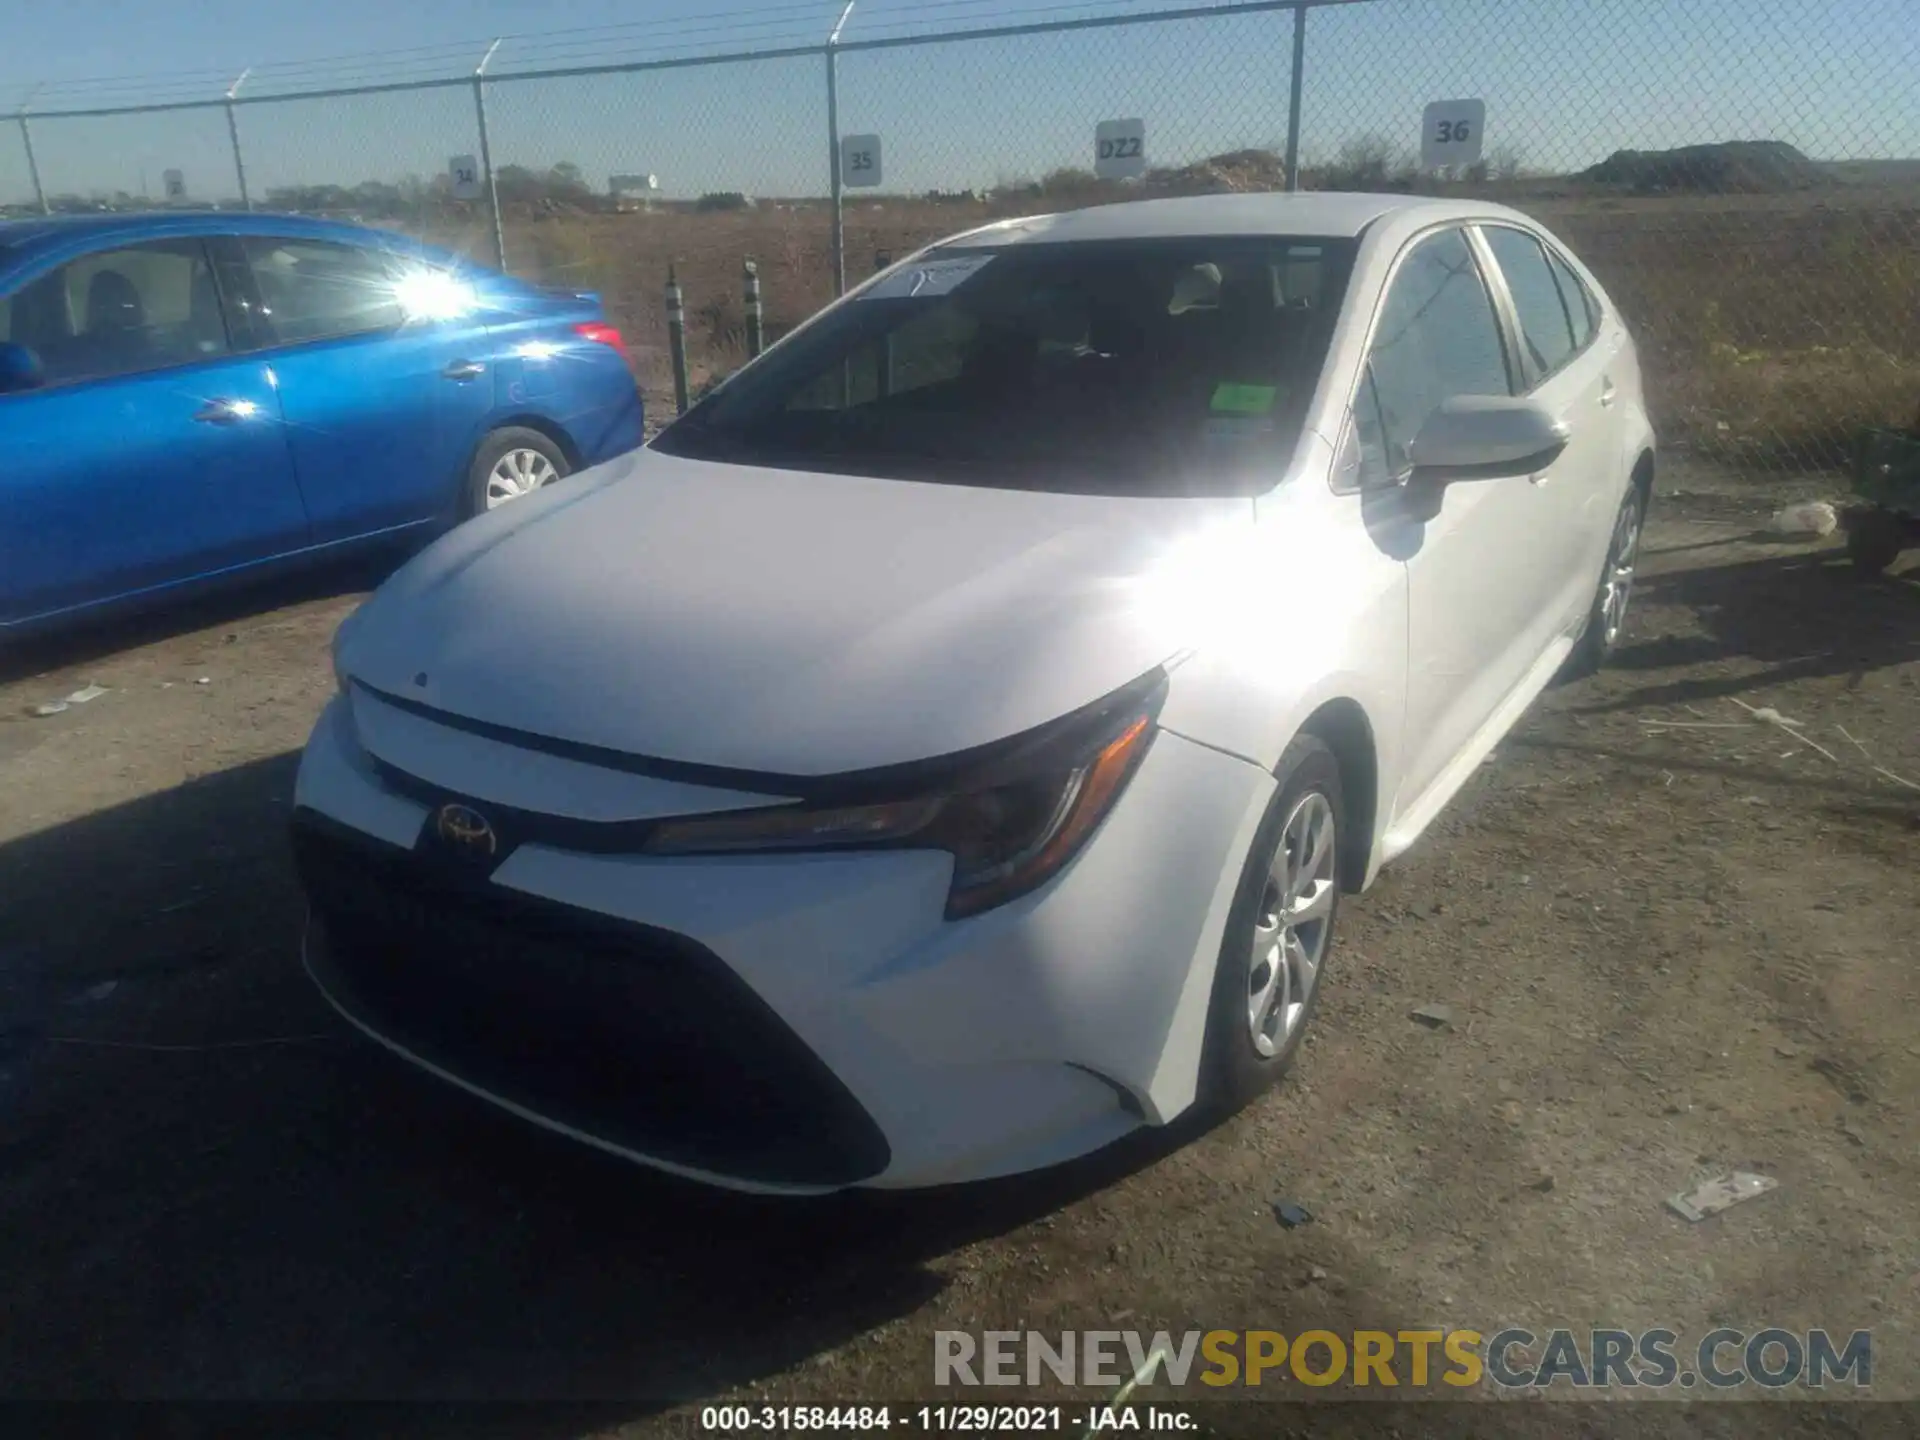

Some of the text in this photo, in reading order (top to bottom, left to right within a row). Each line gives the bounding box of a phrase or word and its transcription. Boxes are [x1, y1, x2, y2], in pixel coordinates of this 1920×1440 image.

[1436, 120, 1470, 143] 36
[1100, 137, 1141, 159] DZ2
[851, 151, 873, 170] 35
